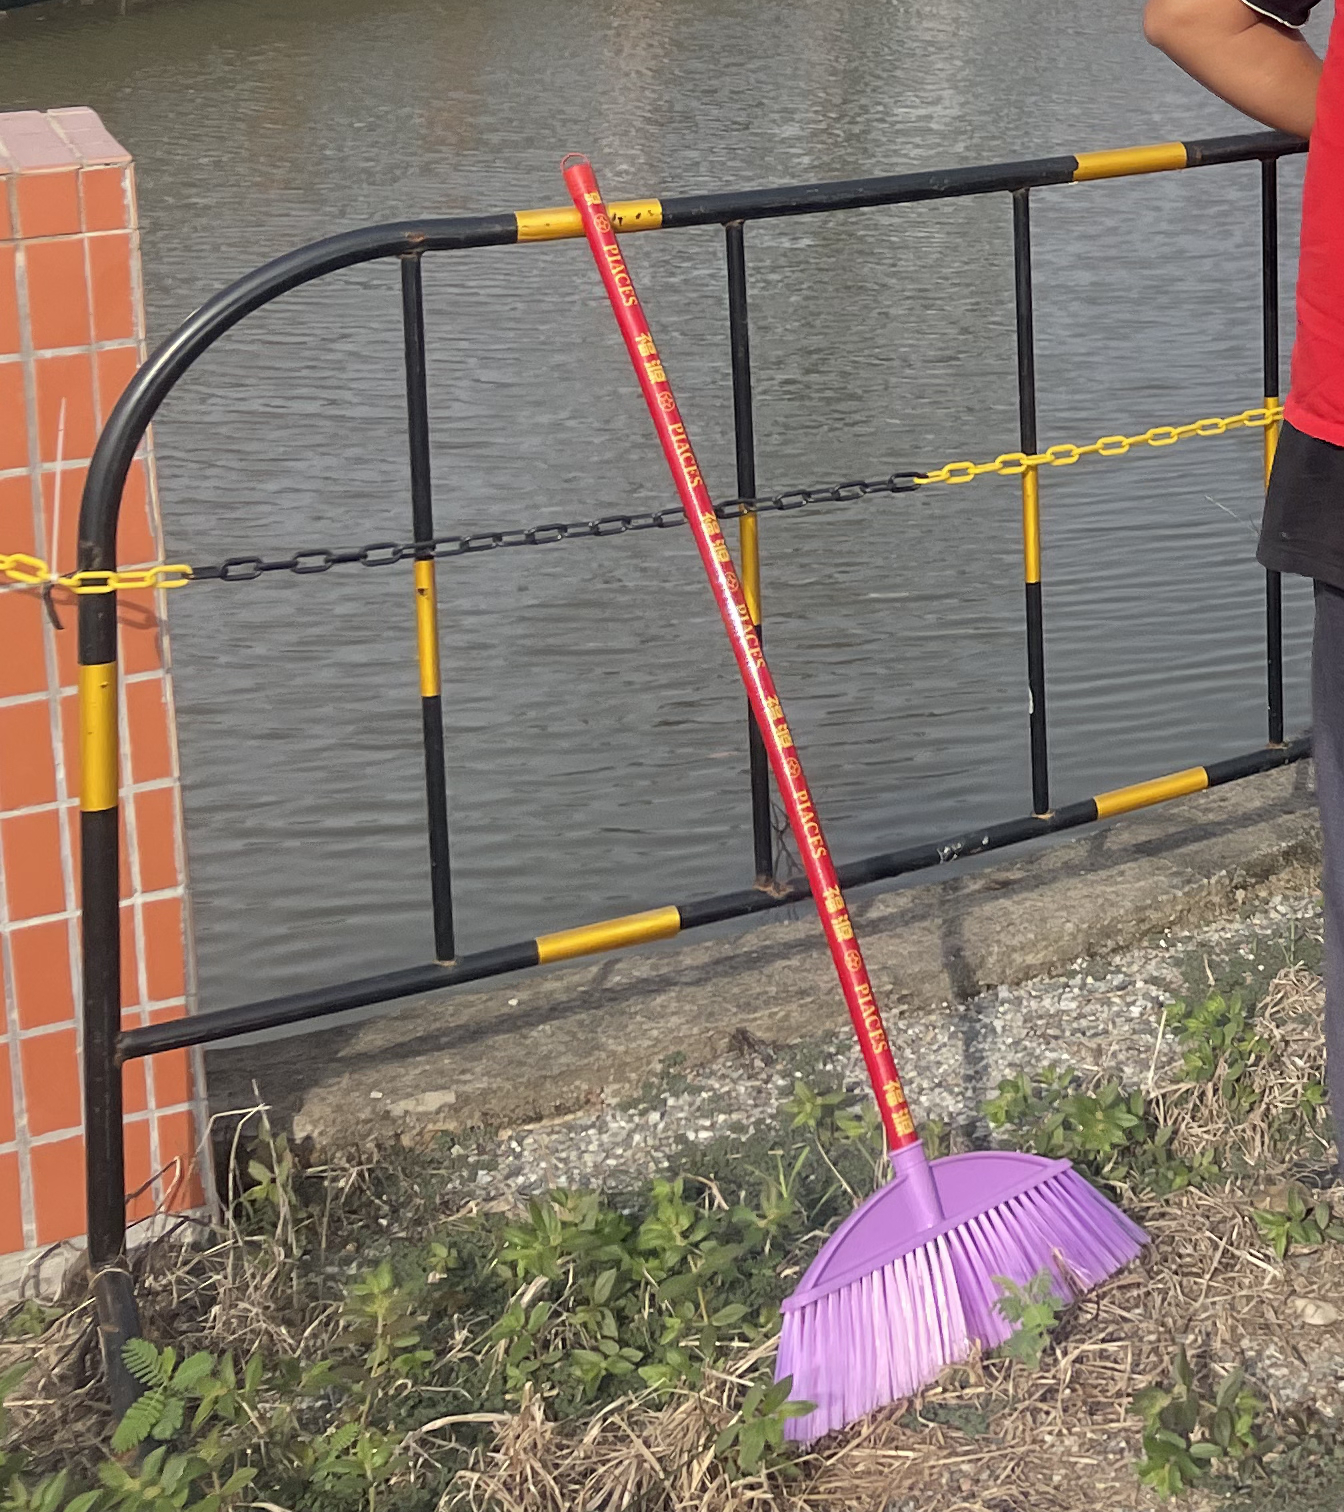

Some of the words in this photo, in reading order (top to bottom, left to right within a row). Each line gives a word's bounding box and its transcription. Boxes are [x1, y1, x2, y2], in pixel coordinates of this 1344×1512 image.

[604, 244, 637, 307] PIACES
[668, 422, 703, 488] PIACES
[796, 789, 827, 860] PIACES
[855, 983, 888, 1055] PIACES
